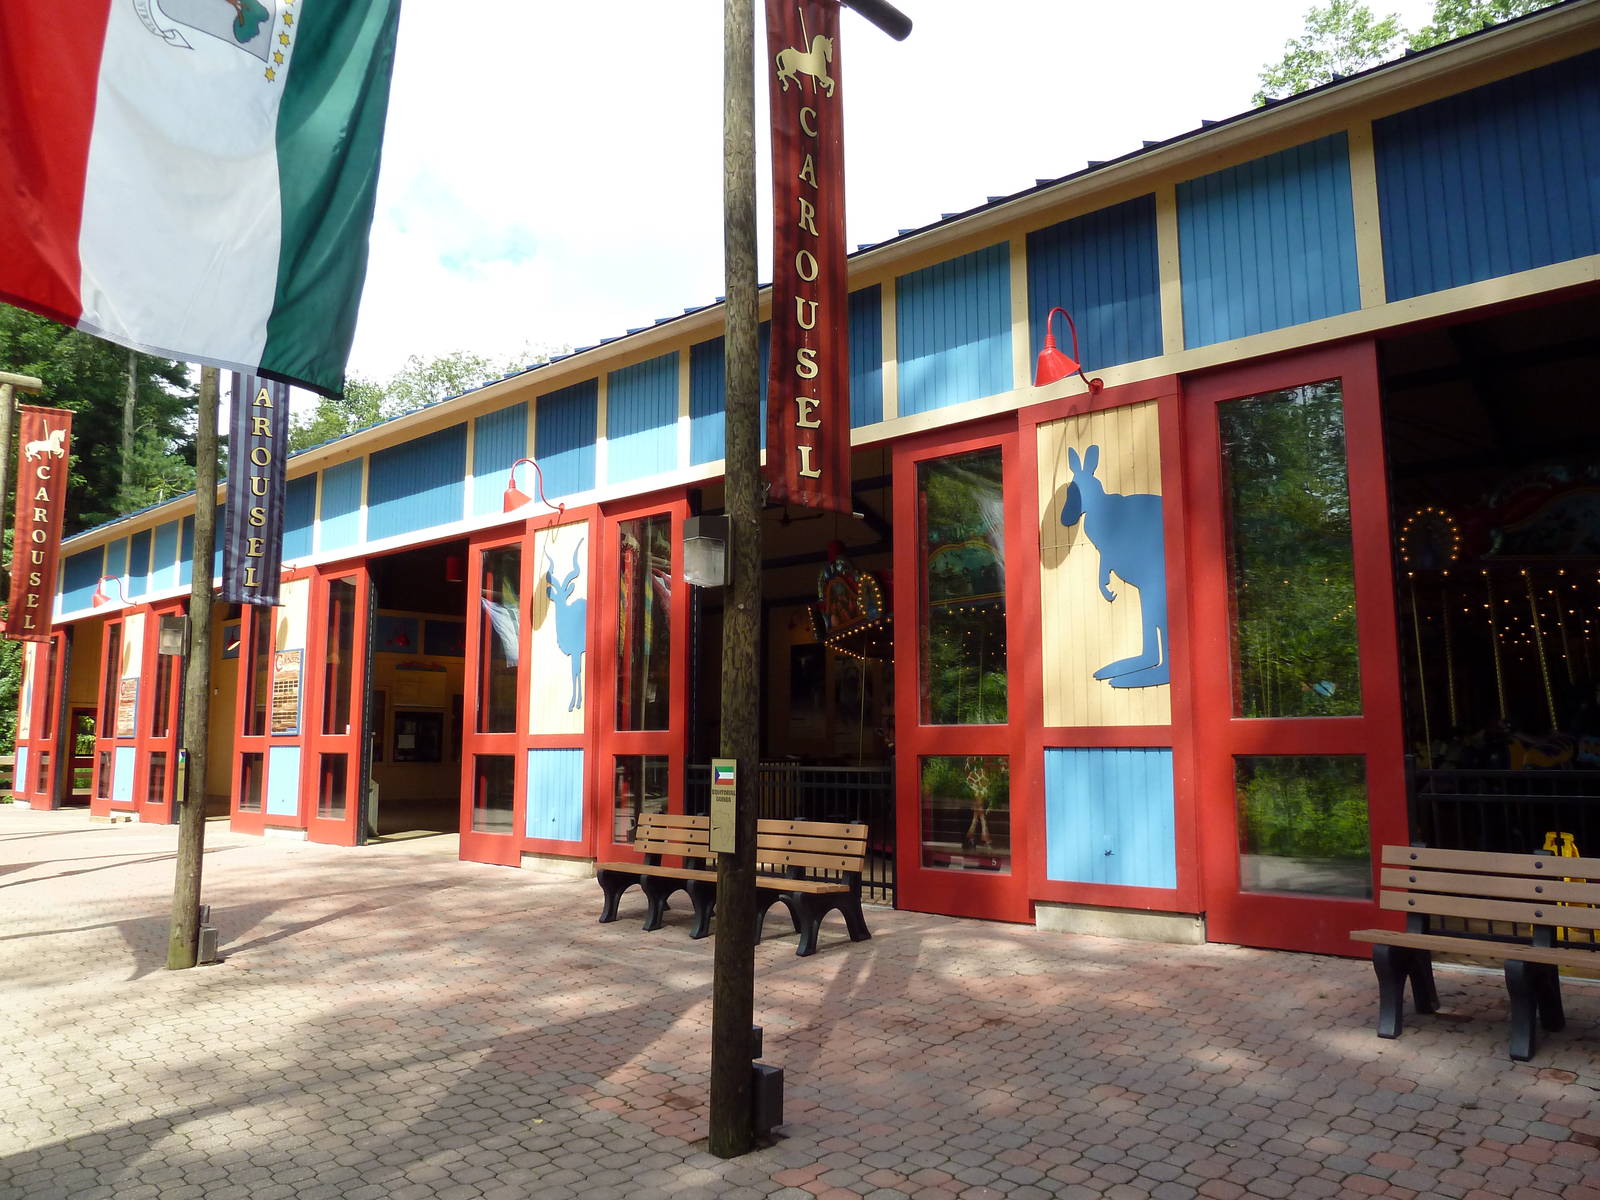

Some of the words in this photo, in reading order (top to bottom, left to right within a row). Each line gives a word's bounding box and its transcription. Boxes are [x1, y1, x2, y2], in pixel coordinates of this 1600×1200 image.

[795, 105, 823, 480] CAROUSEL
[23, 465, 51, 631] CAROUSEL
[243, 386, 275, 589] AROUSEL
